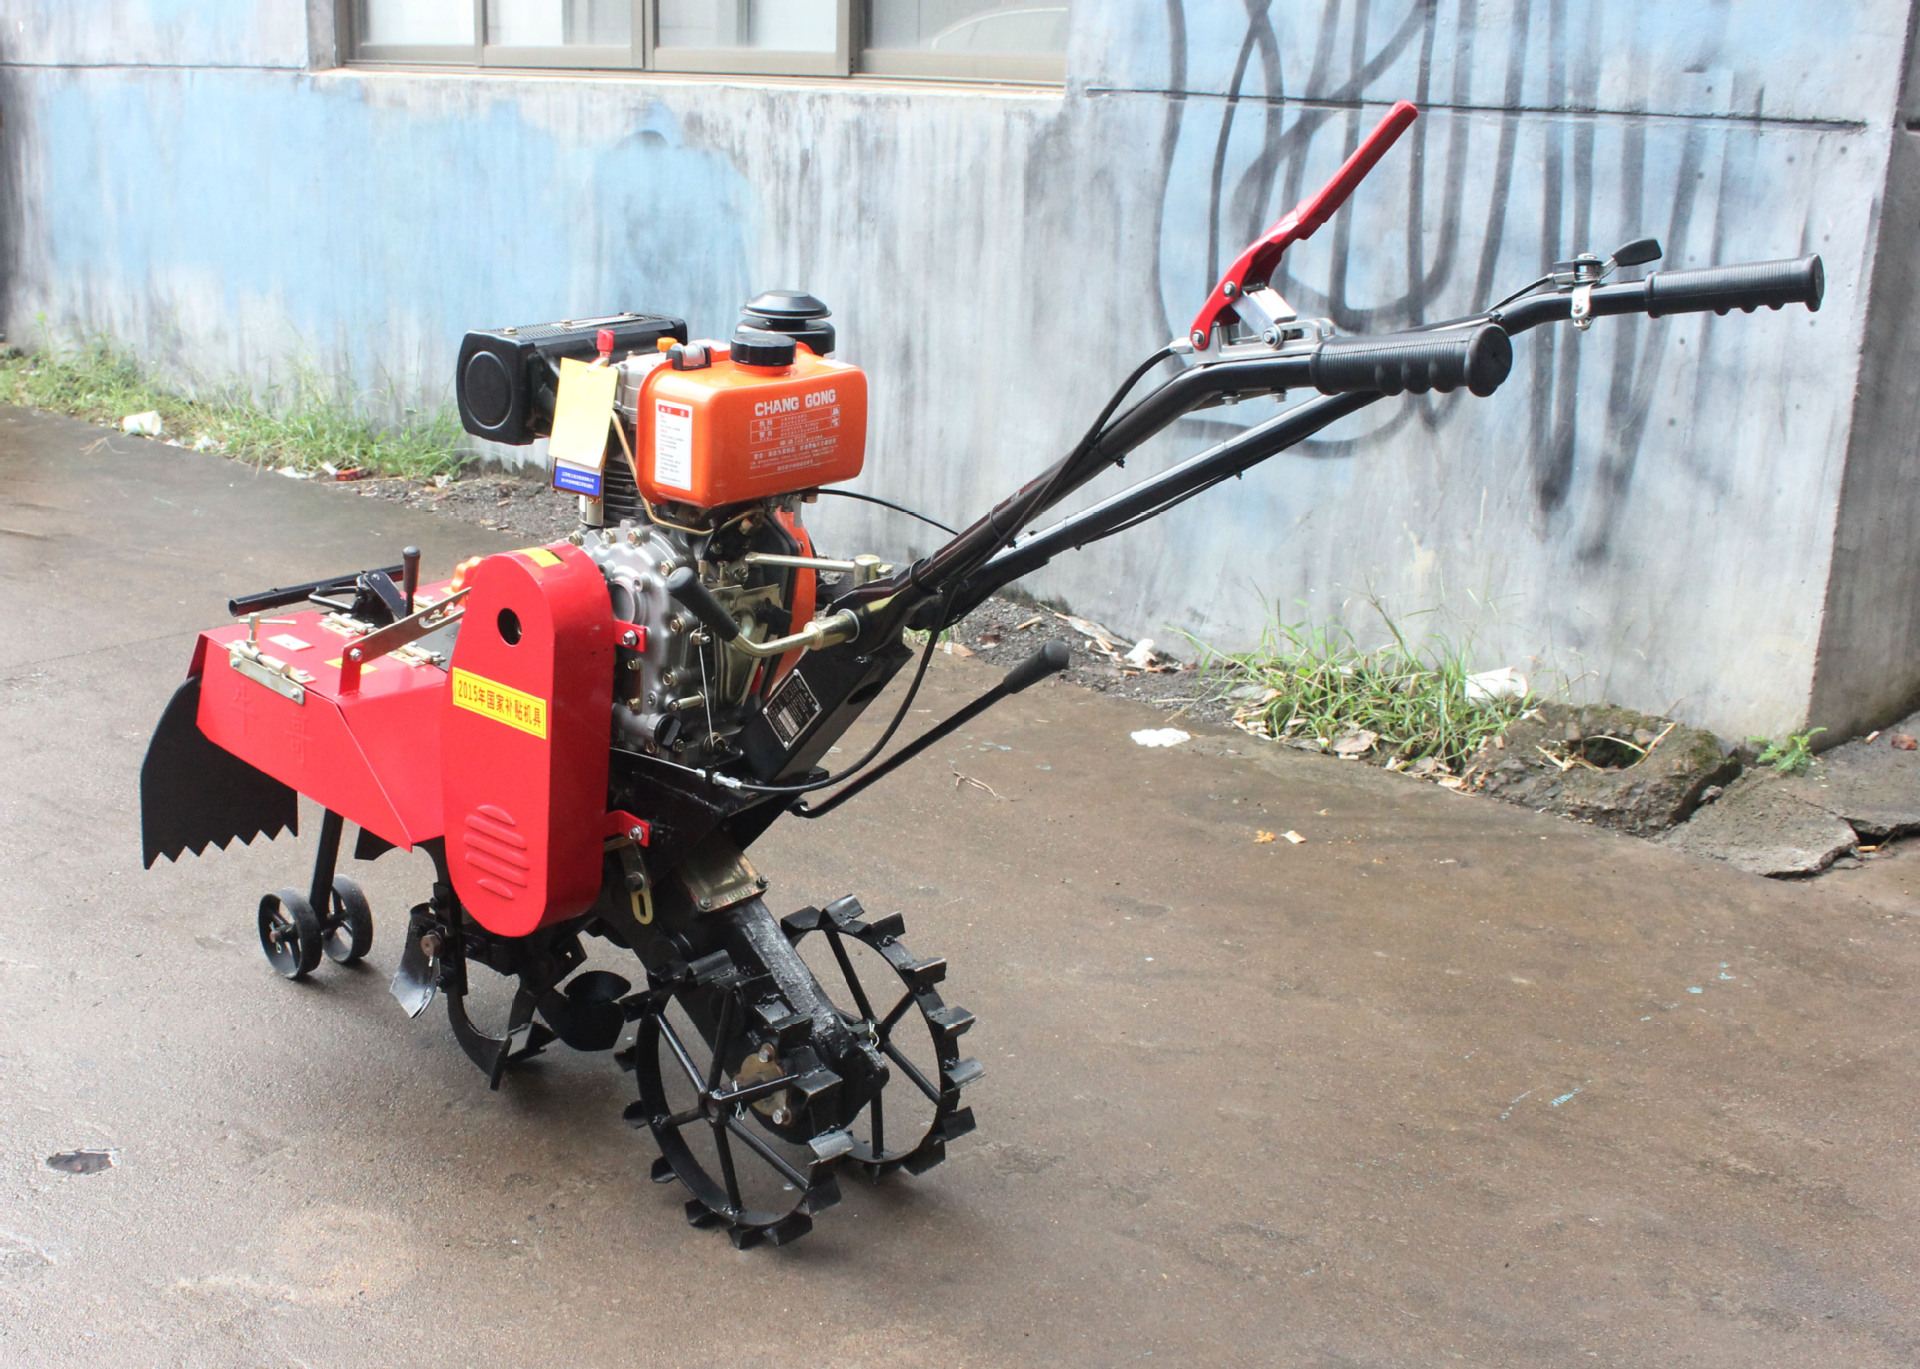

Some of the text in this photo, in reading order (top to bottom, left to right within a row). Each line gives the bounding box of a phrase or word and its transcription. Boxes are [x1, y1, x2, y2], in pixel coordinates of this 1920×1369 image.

[754, 389, 836, 416] CHANG GONG
[458, 679, 541, 728] 2015年国家补贴机具
